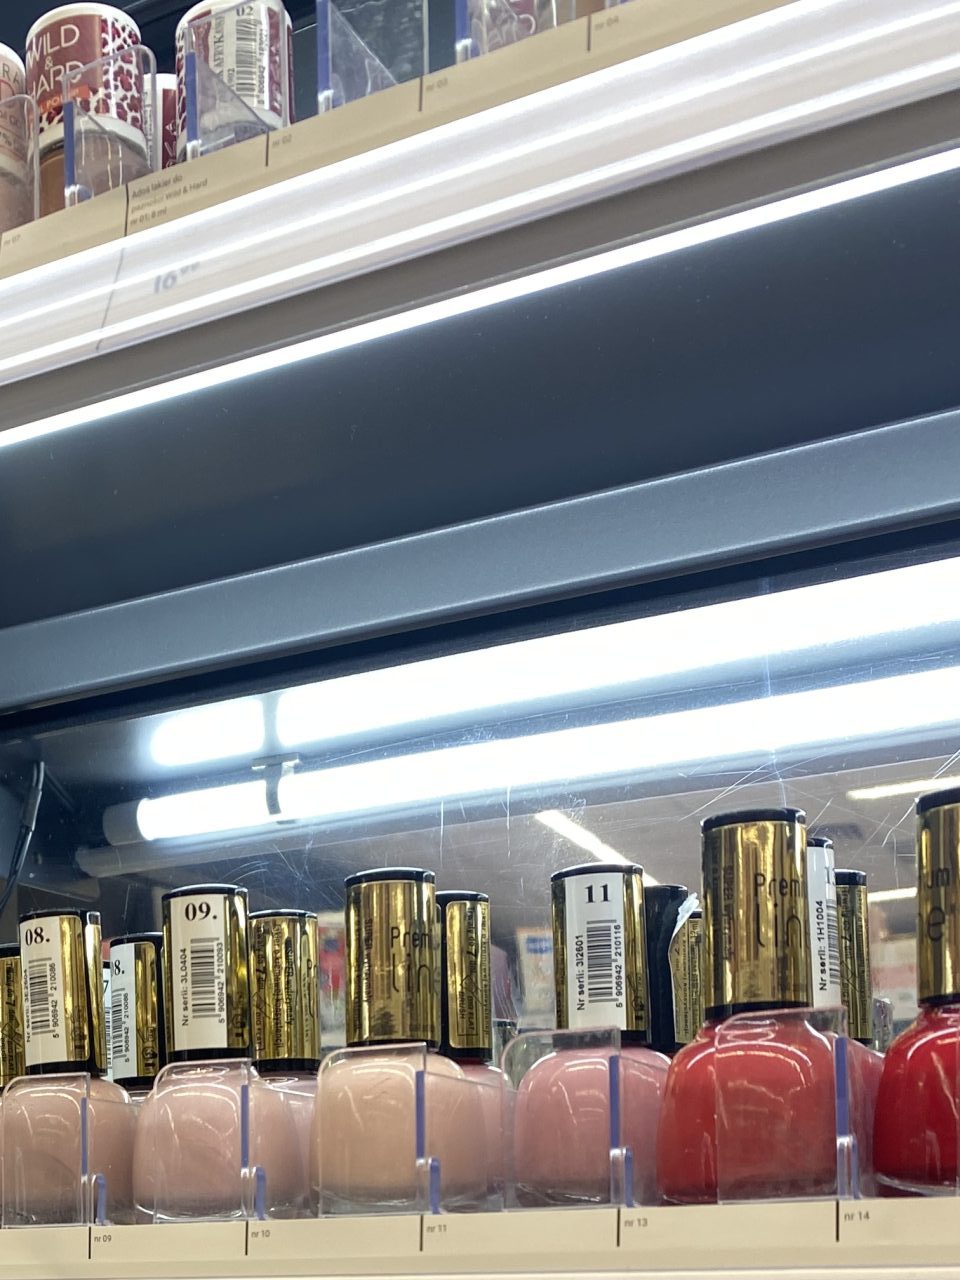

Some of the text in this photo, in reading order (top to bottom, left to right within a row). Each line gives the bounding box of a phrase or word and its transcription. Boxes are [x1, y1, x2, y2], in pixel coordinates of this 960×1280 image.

[26, 23, 80, 69] WILD
[44, 56, 54, 71] &
[172, 174, 183, 185] do
[584, 883, 610, 904] 11
[184, 901, 218, 921] 09.
[815, 899, 827, 939] 1H1004
[24, 925, 51, 946] 08.
[613, 924, 622, 958] 210116
[217, 942, 227, 974] 210093
[180, 947, 189, 1026] Nr serii: 3L0404
[576, 967, 585, 1011] Nr serii:
[615, 963, 623, 1000] 906942
[818, 975, 828, 991] Nr
[217, 981, 226, 1012] 906942
[624, 1217, 648, 1227] nr 13
[844, 1210, 870, 1221] nr 14
[102, 1234, 112, 1243] 09
[261, 1229, 271, 1238] 10
[426, 1223, 447, 1233] nr 11
